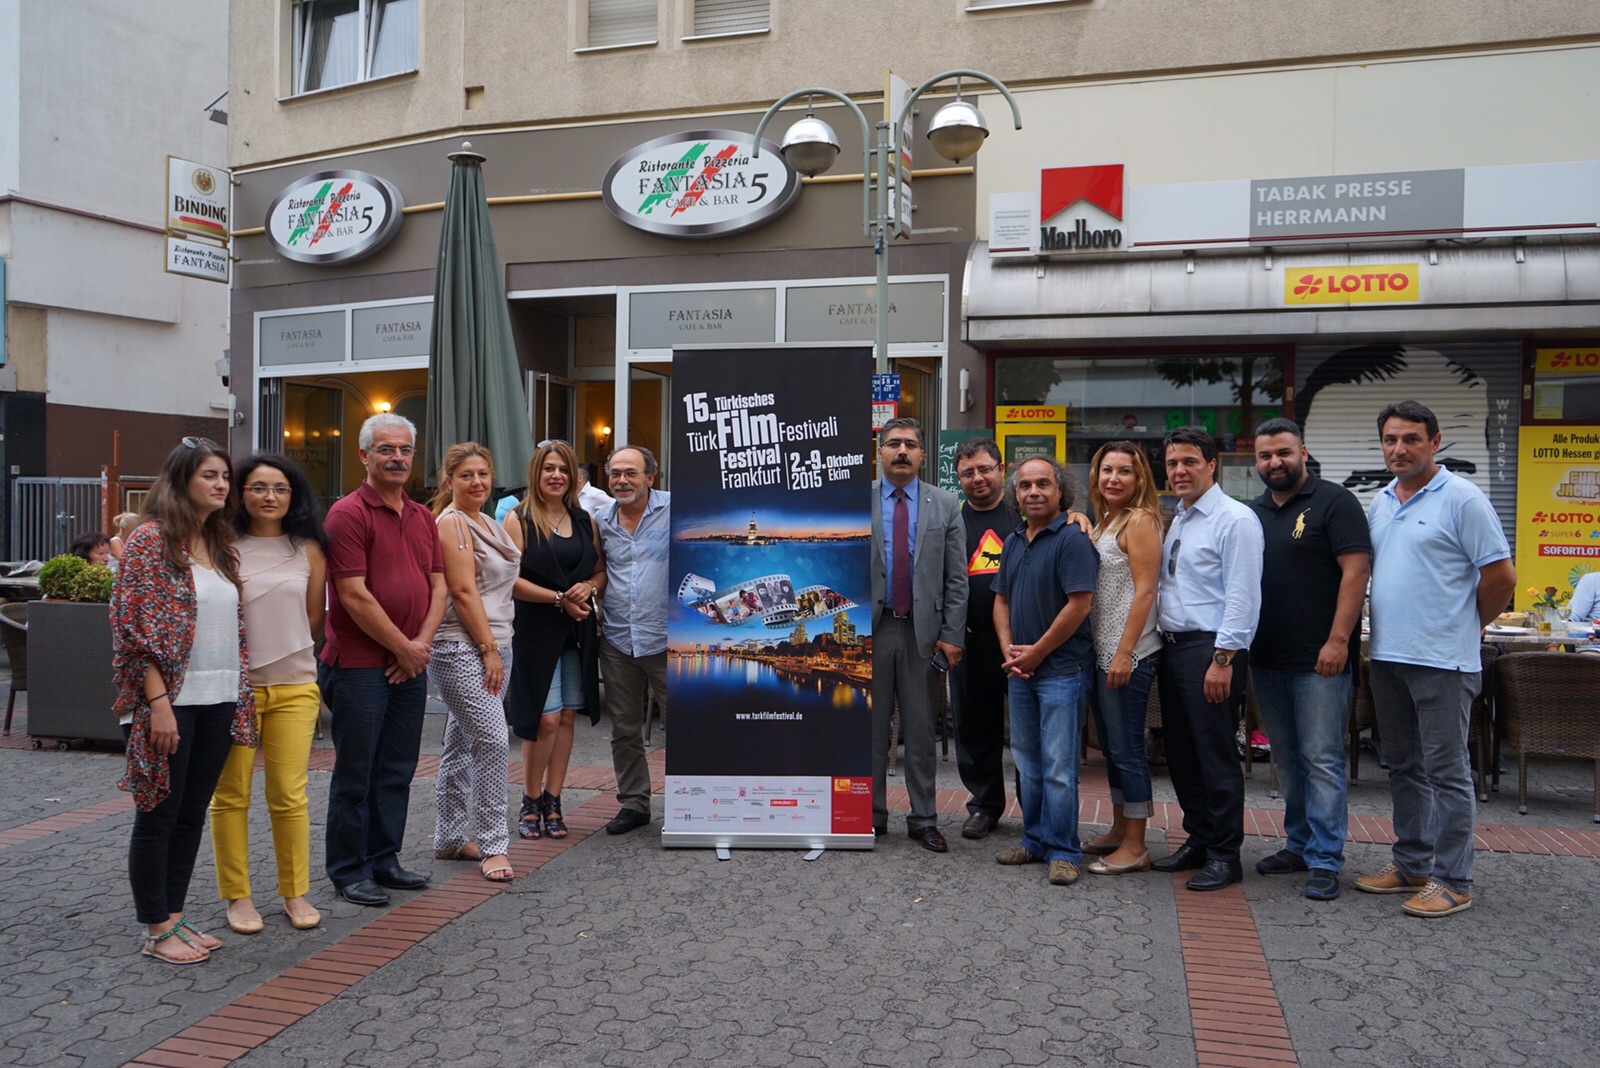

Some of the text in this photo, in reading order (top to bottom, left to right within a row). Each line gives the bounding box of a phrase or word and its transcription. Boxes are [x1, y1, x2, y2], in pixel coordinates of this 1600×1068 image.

[639, 155, 749, 173] Ristorante Pizzeria
[639, 172, 769, 204] FANTASIA 5
[1257, 180, 1412, 202] TABAK PRESSE
[175, 195, 227, 223] BINDING
[288, 191, 361, 210] Ristorante Pizzeria
[699, 198, 708, 206] &
[714, 195, 739, 205] BAR
[288, 206, 374, 234] FANTASIA 5
[1257, 206, 1386, 226] HERRMANN
[337, 226, 354, 236] BAR
[1040, 219, 1122, 250] Marlboro
[174, 255, 225, 273] FANTASIA
[1328, 273, 1409, 293] LOTTO
[668, 309, 733, 321] FANTASIA
[828, 303, 897, 315] FANTAA
[281, 329, 322, 341] FANTASIA
[376, 321, 422, 334] FANTASIA
[679, 323, 698, 331] CAFE
[707, 322, 723, 330] BAR
[1575, 352, 1600, 367] LO
[683, 392, 775, 423] 15. Türkisches
[1021, 409, 1055, 418] LOTTO
[687, 409, 838, 452] Türk Film Festivali
[1553, 434, 1600, 444] Alle Produk
[719, 444, 781, 470] Festival
[790, 450, 864, 472] 2.-9. Oktober
[1533, 448, 1560, 458] LOTTO
[1562, 448, 1592, 459] Hessen
[721, 466, 781, 489] Frankfurt
[791, 468, 851, 490] 2015 Ekim
[1556, 483, 1600, 499] JACKP
[1550, 513, 1594, 523] LOTTO
[735, 711, 803, 720] www.turkfilmfestival.de
